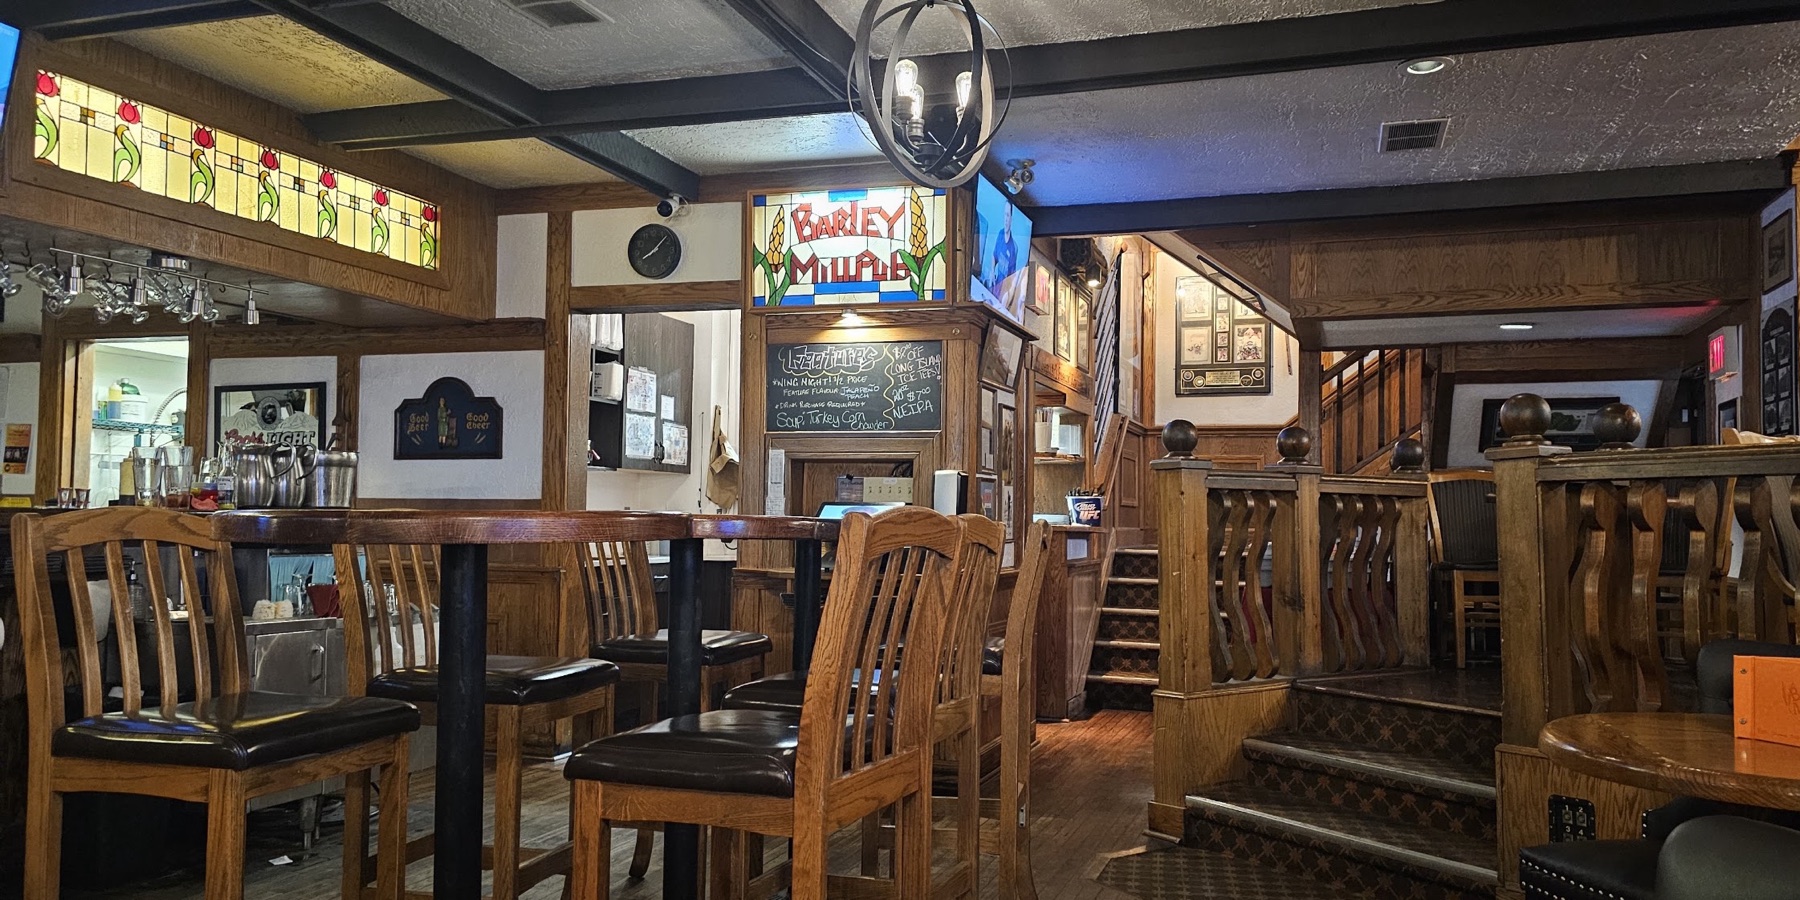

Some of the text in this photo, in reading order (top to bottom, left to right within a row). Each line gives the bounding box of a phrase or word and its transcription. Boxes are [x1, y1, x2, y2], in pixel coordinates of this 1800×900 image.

[792, 201, 905, 243] BARLEY
[907, 346, 924, 360] OFF
[891, 361, 914, 375] LONG
[847, 376, 868, 384] PRICE
[897, 371, 917, 385] ICE
[783, 388, 810, 396] FEATURE
[811, 387, 839, 395] FLAVOUR
[466, 412, 489, 422] Good
[806, 410, 840, 428] Turkey
[851, 418, 888, 430] Chowder
[266, 431, 316, 446] LIGHT
[1079, 510, 1100, 520] UFC
